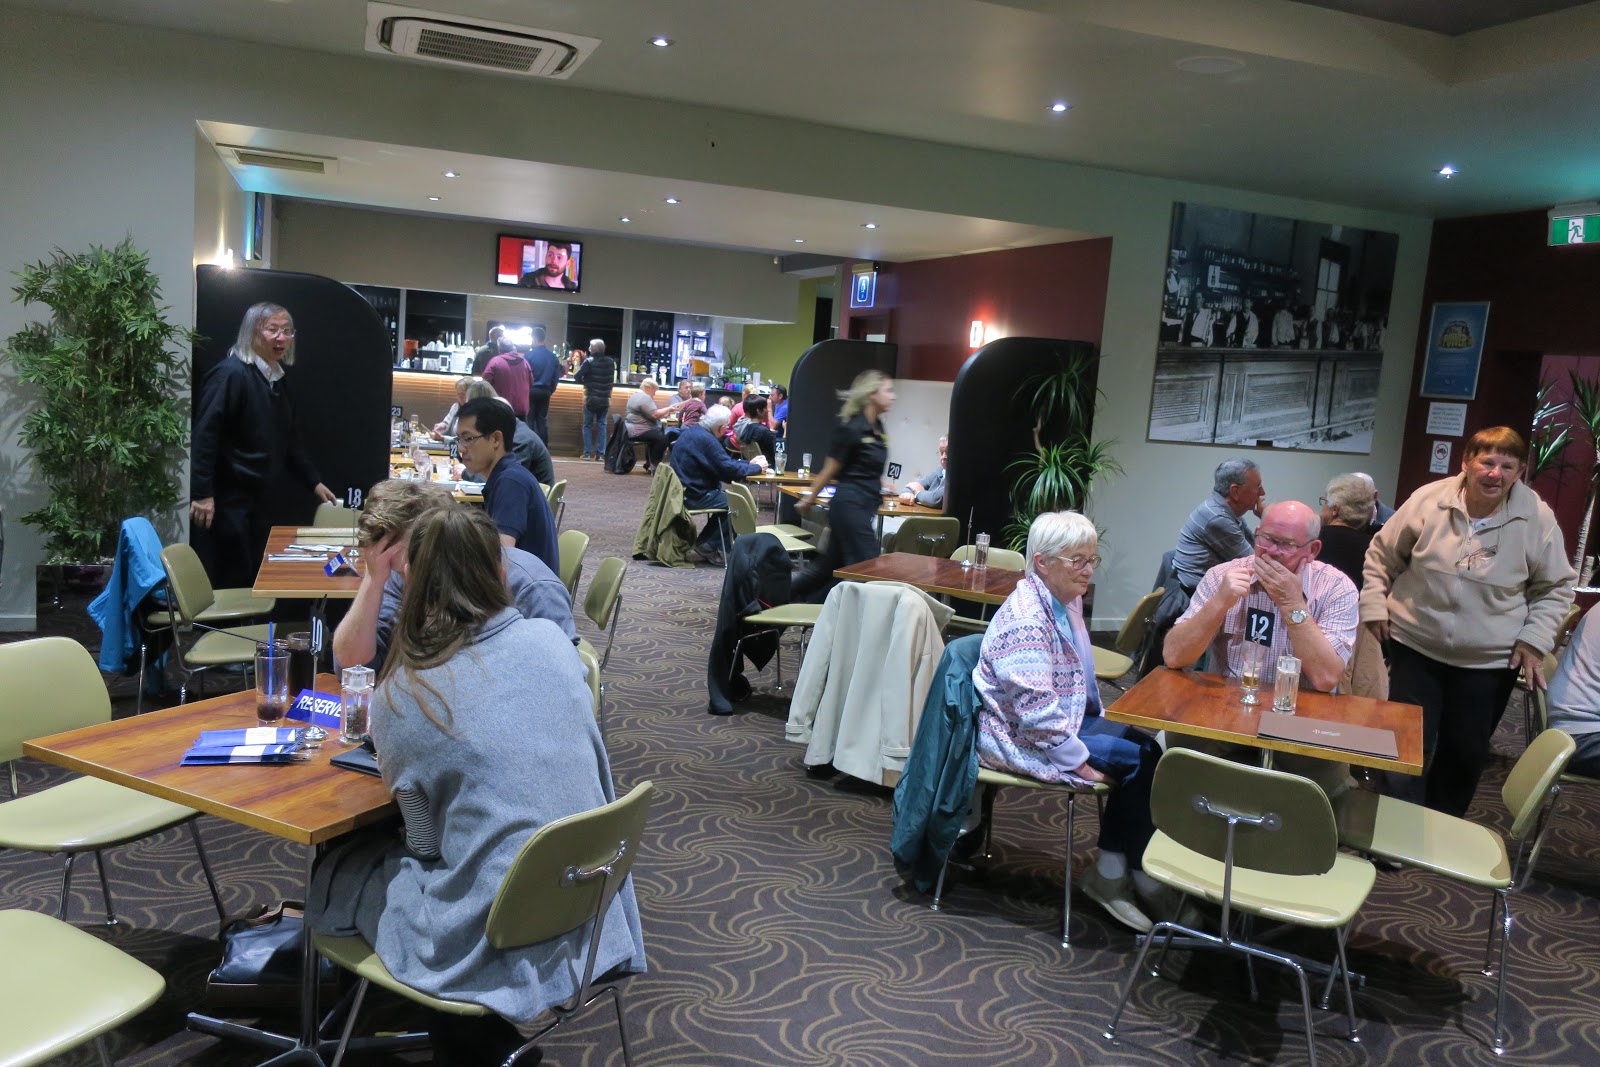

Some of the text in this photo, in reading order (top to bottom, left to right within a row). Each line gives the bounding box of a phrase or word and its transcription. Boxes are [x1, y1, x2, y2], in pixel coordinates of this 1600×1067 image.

[391, 407, 401, 416] 23
[775, 441, 785, 452] 21
[889, 465, 900, 477] 20
[347, 487, 362, 506] 18
[312, 616, 323, 651] 10
[1250, 613, 1270, 641] 12
[296, 695, 341, 717] RESERVE
